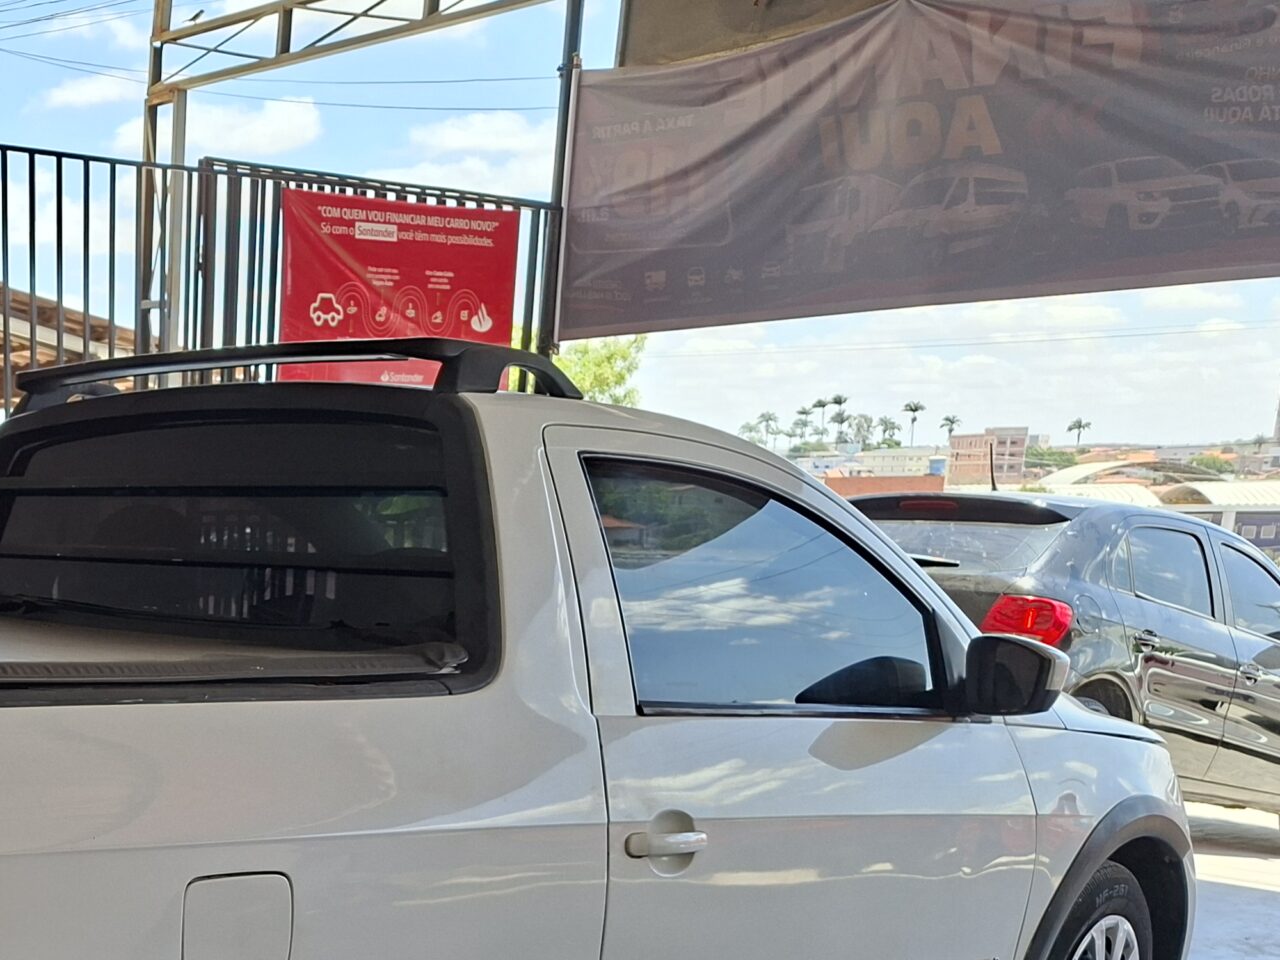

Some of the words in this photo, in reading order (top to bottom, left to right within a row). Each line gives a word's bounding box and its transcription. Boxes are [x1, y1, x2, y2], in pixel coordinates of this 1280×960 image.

[343, 208, 366, 221] QUEM
[368, 210, 385, 222] VOU
[386, 212, 427, 226] FINANCIAR
[428, 216, 444, 227] MEU
[445, 217, 469, 230] CARRO
[320, 222, 331, 234] Só
[332, 225, 348, 236] com
[357, 225, 396, 239] Santander
[398, 229, 414, 241] você
[429, 233, 446, 244] mais
[389, 372, 423, 383] Santander
